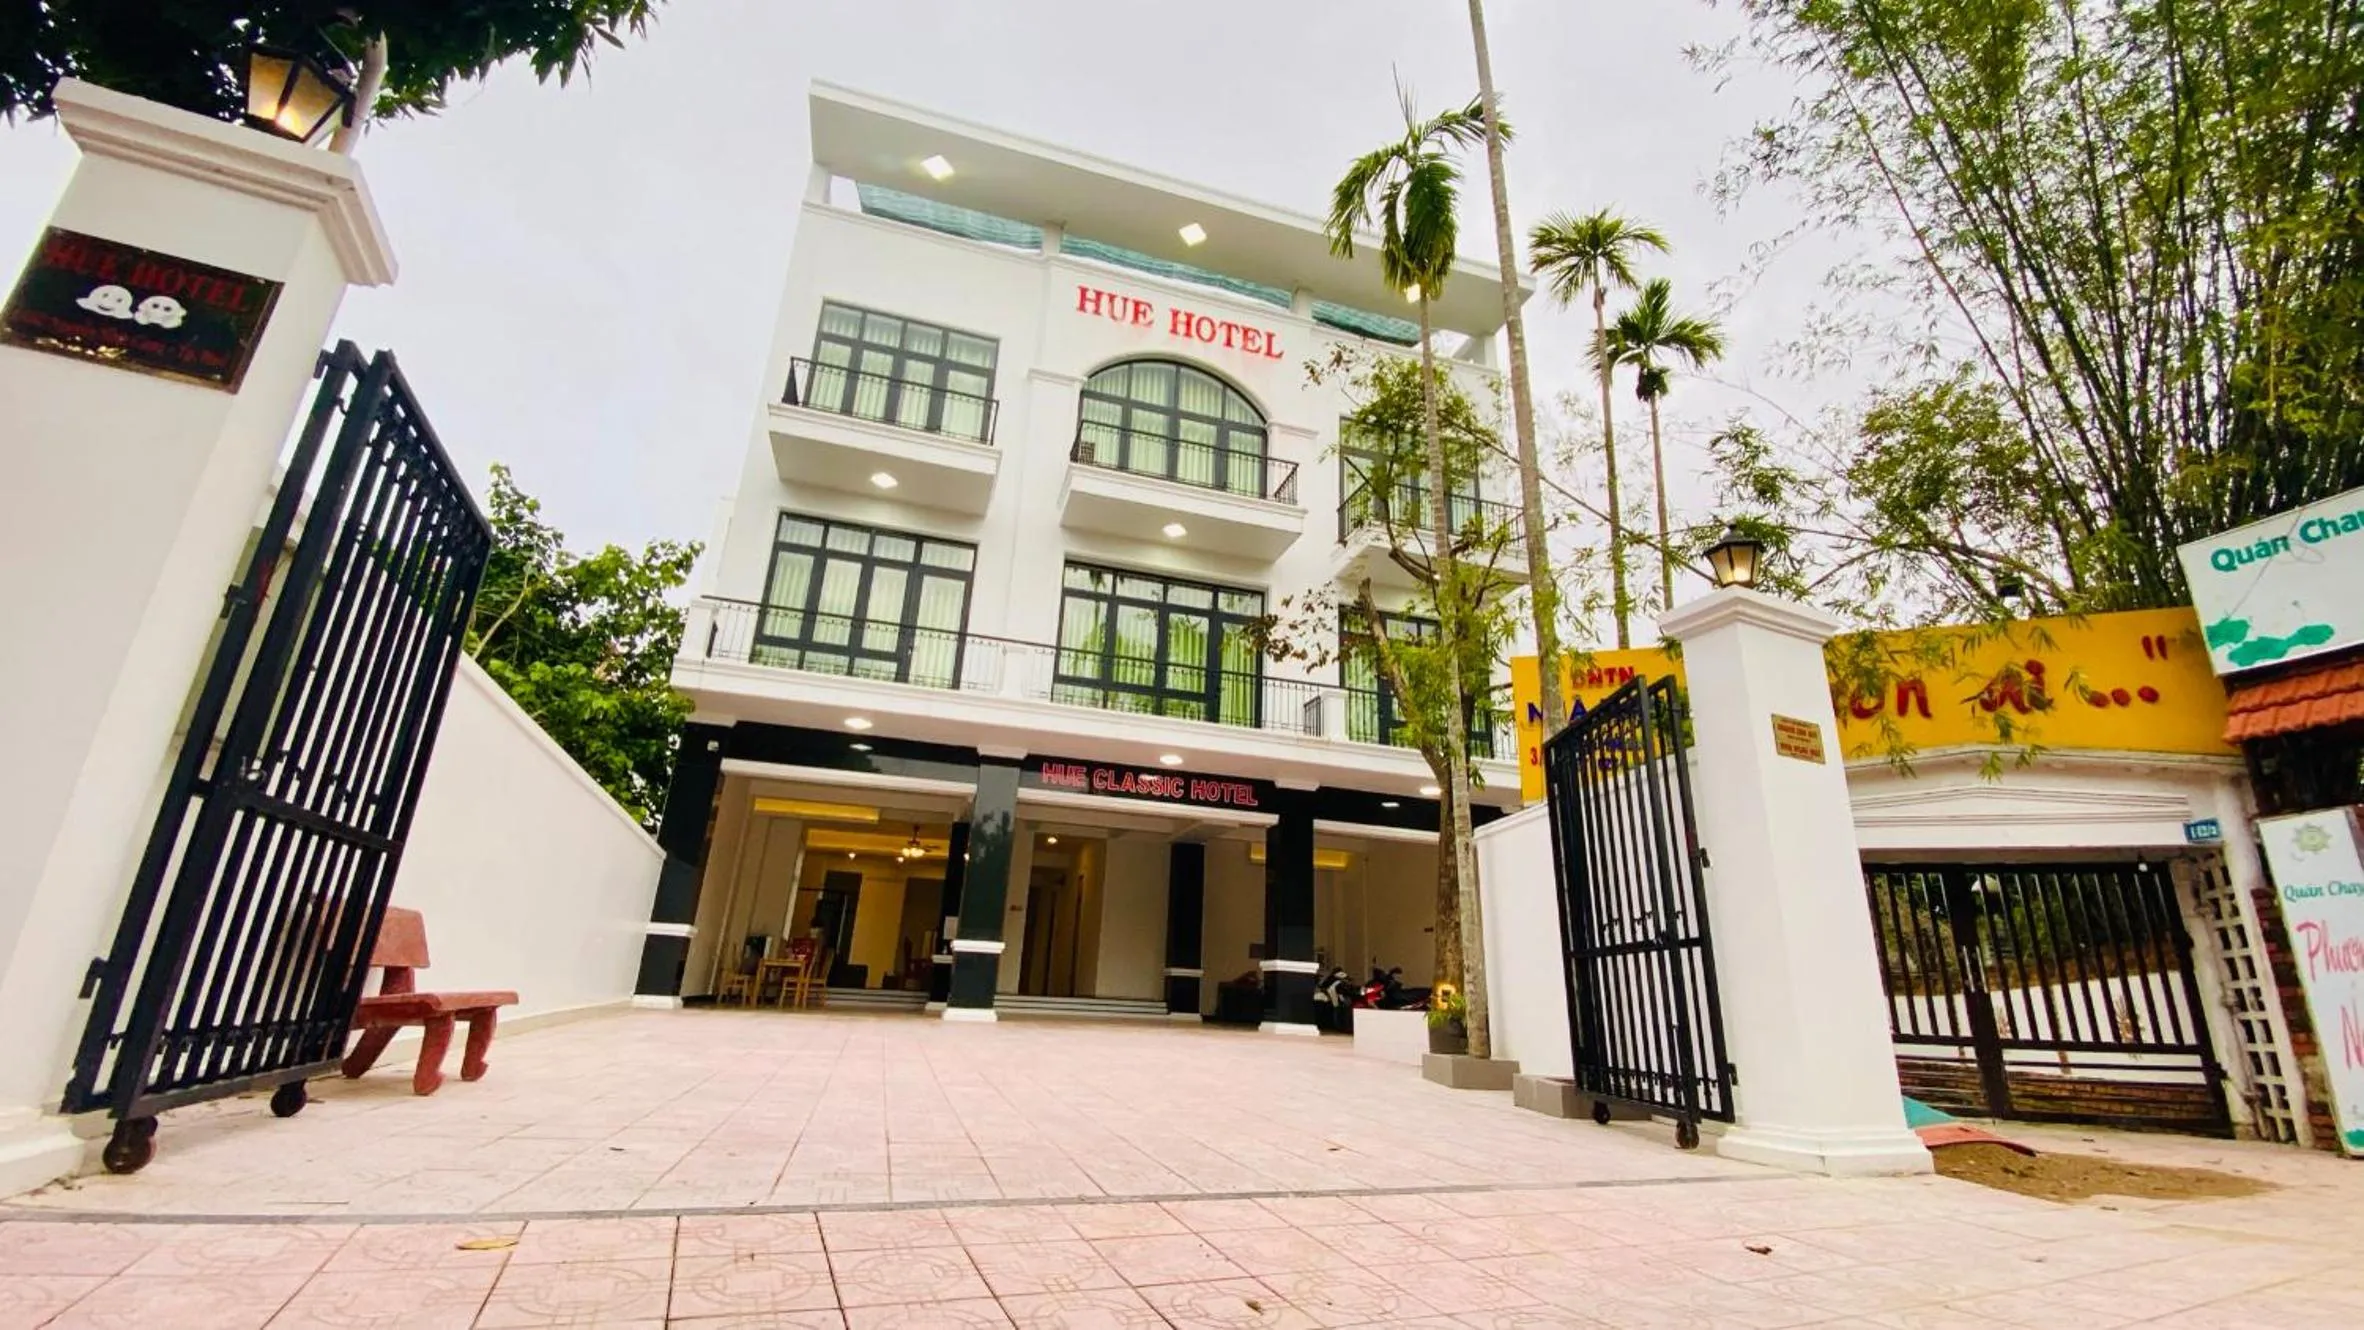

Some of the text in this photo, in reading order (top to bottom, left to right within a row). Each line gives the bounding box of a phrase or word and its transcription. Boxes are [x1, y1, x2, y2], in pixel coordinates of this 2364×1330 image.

[128, 260, 250, 313] HOTEL
[1077, 286, 1284, 360] HUE HOTEL
[1042, 762, 1258, 806] HUE CLASSIC HOTEL
